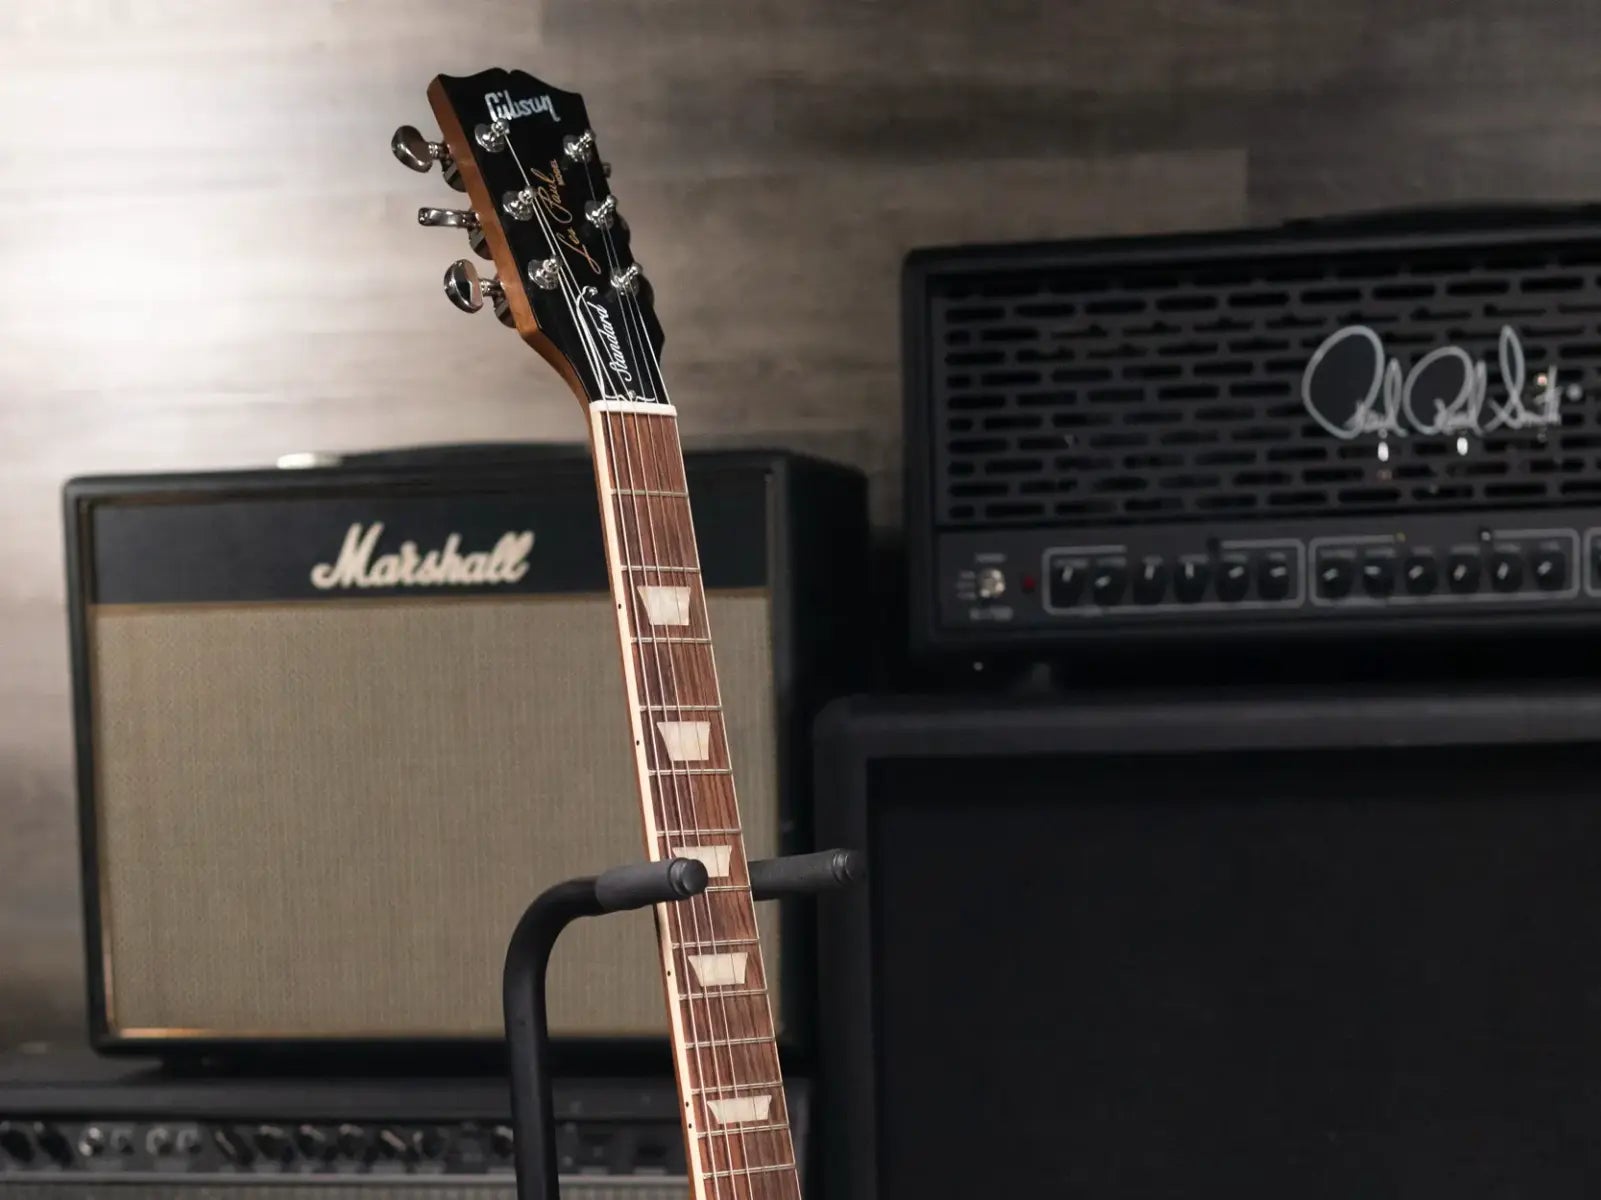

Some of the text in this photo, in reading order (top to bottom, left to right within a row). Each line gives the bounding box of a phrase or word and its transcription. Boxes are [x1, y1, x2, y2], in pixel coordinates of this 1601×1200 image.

[484, 89, 561, 122] Gibson
[530, 167, 573, 224] Paul
[587, 301, 632, 382] Standard
[311, 522, 534, 589] Marshall
